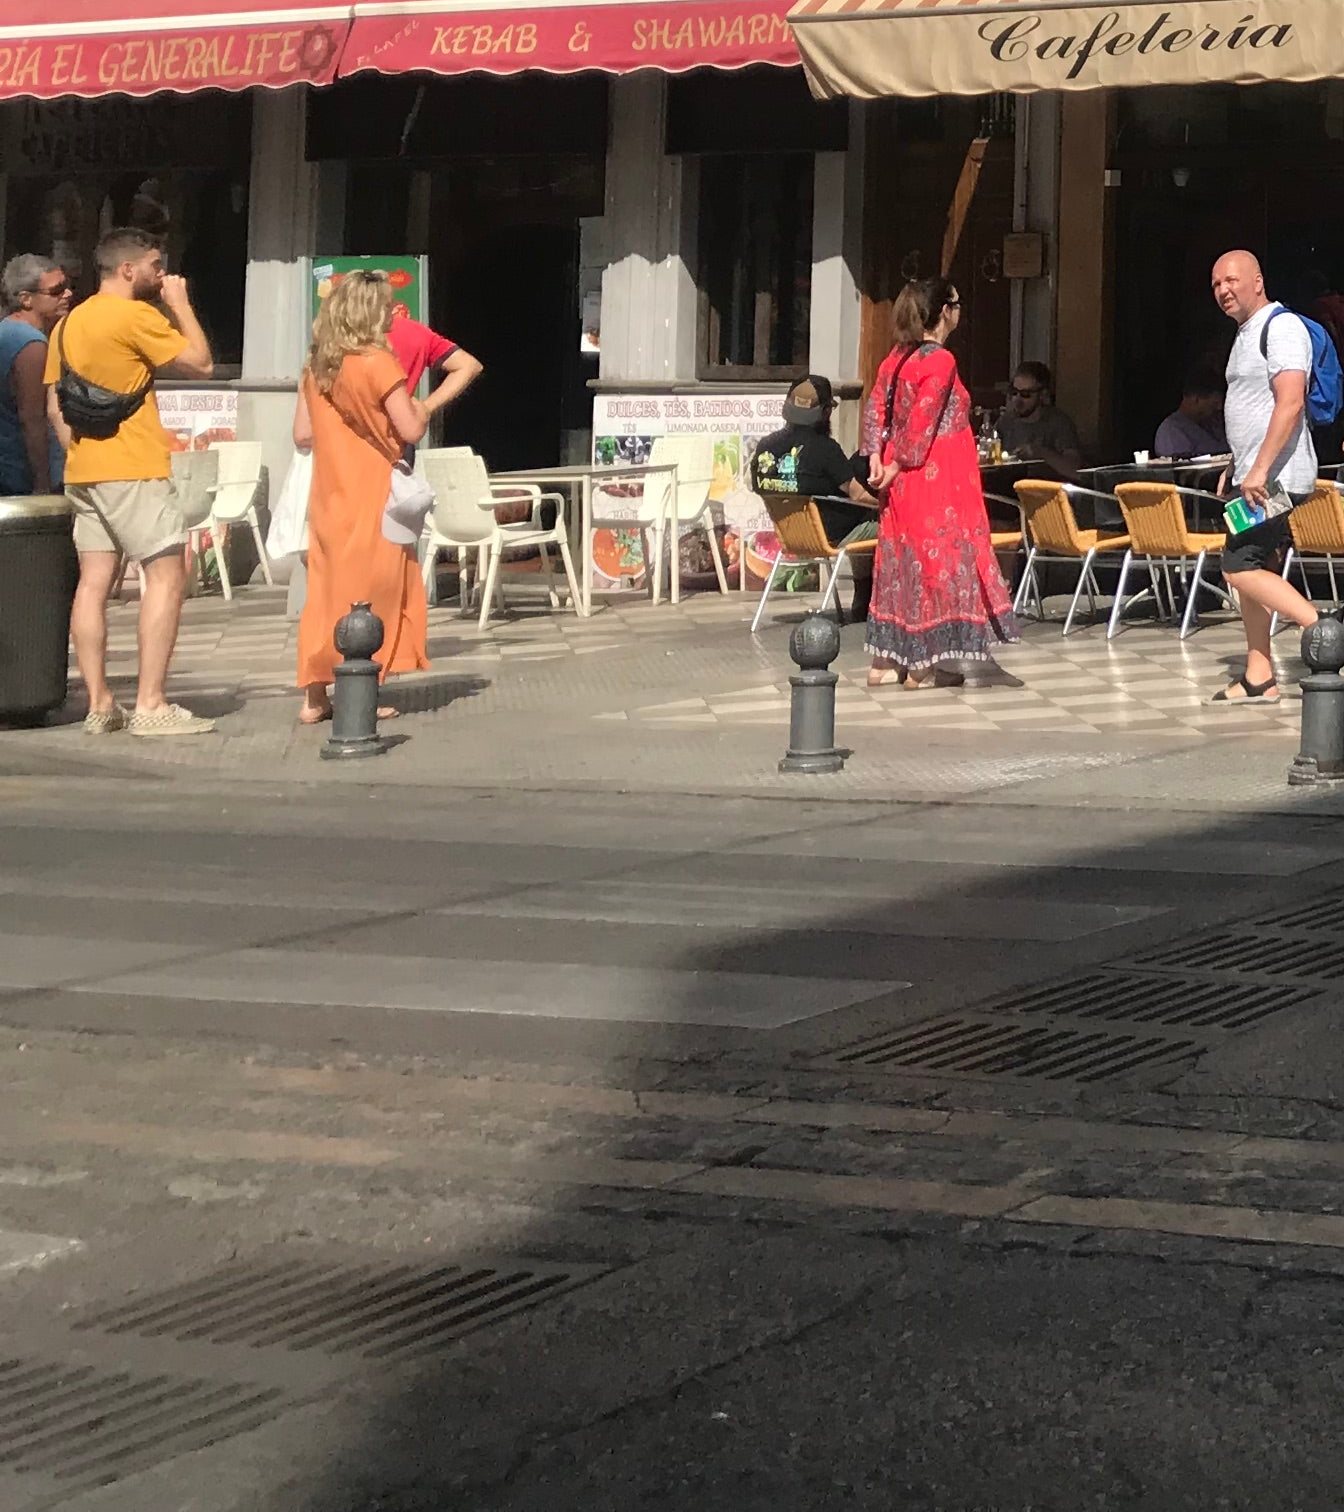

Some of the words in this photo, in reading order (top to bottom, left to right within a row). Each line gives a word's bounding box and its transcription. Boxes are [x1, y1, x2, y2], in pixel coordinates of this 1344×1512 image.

[430, 23, 538, 55] KEBAB
[568, 22, 592, 52] &
[632, 12, 798, 51] SHAWARM
[977, 12, 1295, 80] Cafetería
[51, 44, 88, 86] EL
[99, 30, 302, 87] GENERALIFE
[180, 395, 224, 412] DESDE
[606, 400, 661, 419] DULCES,
